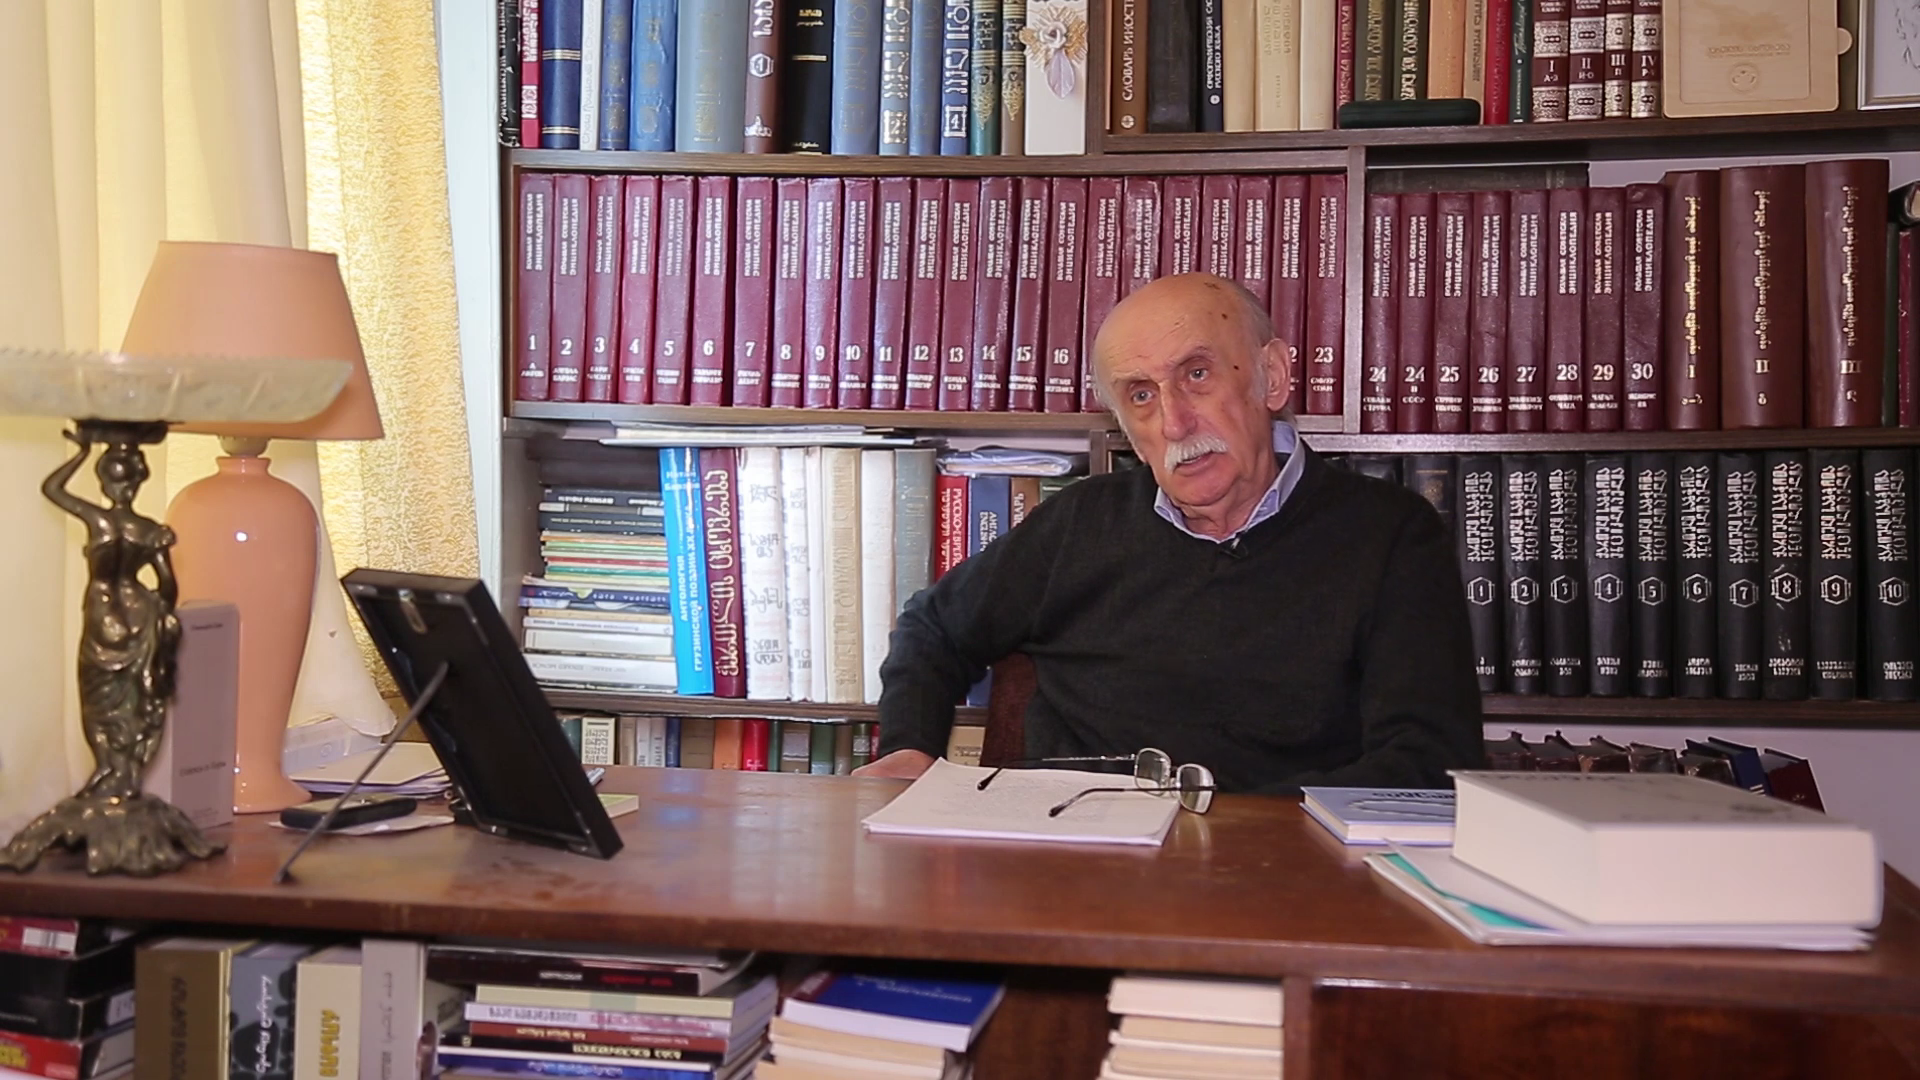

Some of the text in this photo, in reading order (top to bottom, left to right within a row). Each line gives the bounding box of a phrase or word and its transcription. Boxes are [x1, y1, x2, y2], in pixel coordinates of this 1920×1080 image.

[1550, 60, 1554, 72] I
[1582, 58, 1591, 69] II
[1611, 54, 1625, 66] III
[1641, 55, 1656, 67] IV
[1122, 48, 1134, 101] СЛОВАРЬ
[1754, 191, 1771, 227] ქართული
[1320, 198, 1328, 240] СОВЕТСКАЯ
[525, 194, 534, 270] БОЛЬШАЯ СОВЕТСКАЯ
[534, 194, 544, 270] ЭНЦИКЛОПЕДИЯ
[781, 201, 791, 278] БОЛЬШАЯ СОВЕТСКАЯ
[790, 201, 800, 278] ЭНЦИКЛОПЕДИЯ
[848, 201, 857, 278] БОЛЬШАЯ СОВЕТСКАЯ
[857, 201, 866, 278] ЭНЦИКЛОПЕДИЯ
[1021, 200, 1032, 278] БОЛЬШАЯ СОВЕТСКАЯ
[1029, 200, 1041, 278] ЭНЦИКЛОПЕДИЯ
[1328, 198, 1337, 277] ЭНЦИКЛОПЕДИЯ
[951, 203, 961, 280] БОЛЬШАЯ СОВЕТСКАЯ
[959, 203, 970, 280] ЭНЦИКЛОПЕДИЯ
[1057, 202, 1066, 280] БОЛЬШАЯ СОВЕТСКАЯ
[1065, 203, 1076, 281] ЭНЦИКЛОПЕДИЯ
[1408, 217, 1417, 296] БОЛЬШАЯ СОВЕТСКАЯ
[1417, 217, 1427, 297] ЭНЦИКЛОПЕДИЯ
[1444, 216, 1454, 296] БОЛЬШАЯ СОВЕТСКАЯ
[1453, 216, 1464, 297] ЭНЦИКЛОПЕДИЯ
[1568, 212, 1577, 294] ЭНЦИКЛОПЕДИЯ
[1634, 210, 1644, 291] БОЛЬШАЯ СОВЕТСКАЯ
[1644, 209, 1654, 291] ЭНЦИКЛОПЕДИЯ
[1559, 258, 1567, 293] БОЛЬШАЯ
[528, 335, 536, 350] 1
[561, 339, 572, 355] 2
[594, 337, 605, 353] 3
[629, 339, 639, 354] 4
[664, 341, 674, 356] 5
[703, 340, 714, 356] 6
[745, 342, 756, 357] 7
[780, 344, 791, 360] 8
[815, 345, 825, 360] 9
[845, 345, 860, 360] 10
[879, 346, 892, 361] 11
[913, 345, 929, 360] 12
[948, 347, 964, 363] 13
[982, 346, 996, 360] 14
[1016, 346, 1031, 362] 15
[1053, 349, 1069, 364] 16
[1314, 347, 1333, 362] 23
[1369, 366, 1386, 382] 24
[1405, 366, 1425, 382] 24
[1440, 366, 1459, 382] 25
[1478, 366, 1499, 383] 26
[1517, 366, 1537, 382] 27
[1557, 365, 1577, 381] 28
[1593, 364, 1614, 380] 29
[1632, 363, 1653, 380] 30
[1688, 365, 1695, 377] I
[1756, 360, 1769, 373] II
[1465, 472, 1480, 561] ქართული საბჭოთა
[1480, 472, 1494, 561] ენციკლოპედია
[1509, 472, 1524, 561] ქართული საბჭოთა
[1524, 471, 1539, 560] ენციკლოპედია
[1596, 467, 1610, 558] ქართული საბჭოთა
[1611, 467, 1624, 558] ენციკლოპედია
[1680, 466, 1696, 558] ქართული საბჭოთა
[1696, 465, 1712, 558] ენციკლოპედია
[1772, 463, 1787, 557] ქართული საბჭოთა
[1788, 462, 1803, 557] ენციკლოპედია
[1821, 465, 1836, 559] ქართული საბჭოთა
[1837, 465, 1851, 559] ენციკლოპედია
[688, 552, 698, 597] ПОЭЗИИ
[705, 470, 738, 676] ქართლის ცხოვრება
[676, 555, 688, 621] АНТОЛОГИЯ
[1478, 585, 1484, 596] 1
[1521, 585, 1528, 597] 2
[1561, 583, 1568, 595] 3
[1605, 582, 1612, 594] 4
[1649, 585, 1657, 597] 5
[1693, 582, 1701, 595] 6
[1740, 587, 1748, 599] 7
[1782, 582, 1792, 595] 8
[1832, 582, 1840, 596] 9
[1886, 584, 1902, 597] 10
[690, 599, 702, 671] ГРУЗИНСКОЙ
